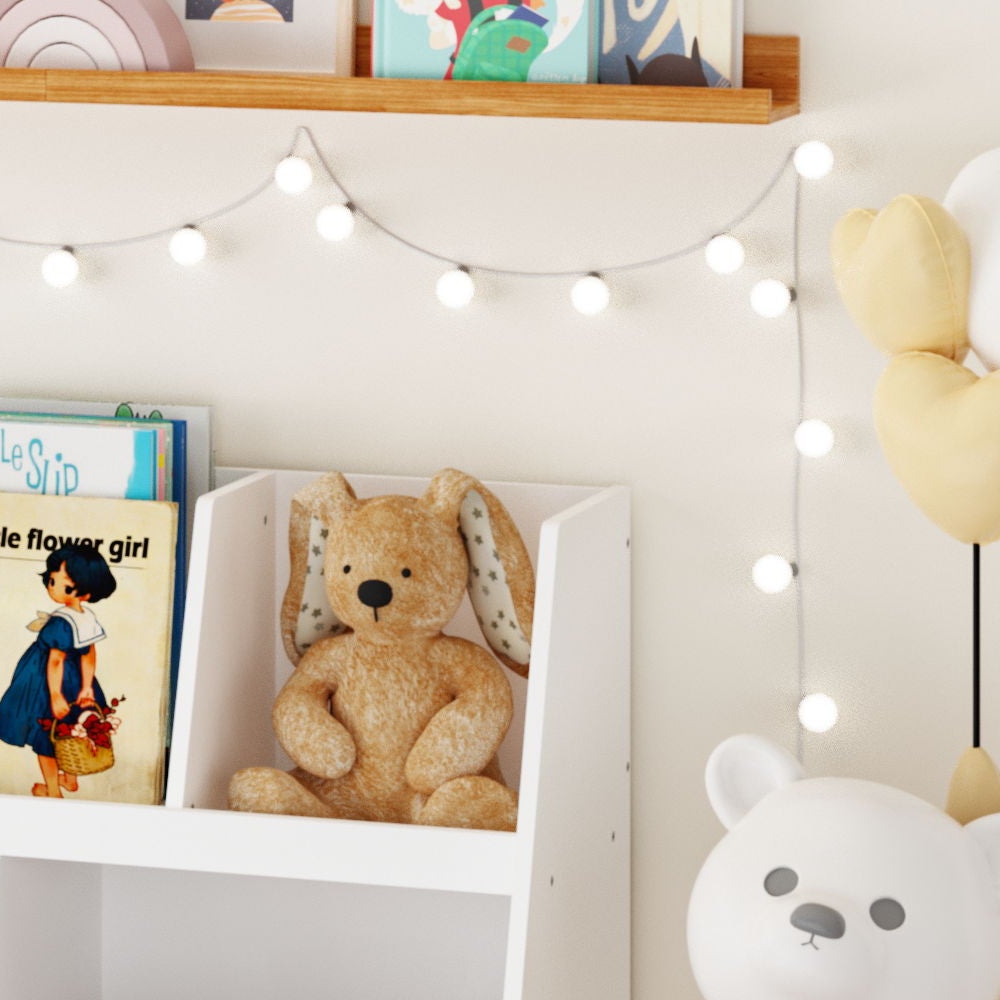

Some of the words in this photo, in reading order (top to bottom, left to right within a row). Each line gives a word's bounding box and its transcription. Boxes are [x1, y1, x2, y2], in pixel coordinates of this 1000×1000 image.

[0, 428, 23, 471] Le
[26, 438, 79, 496] Slip
[109, 536, 150, 563] girl
